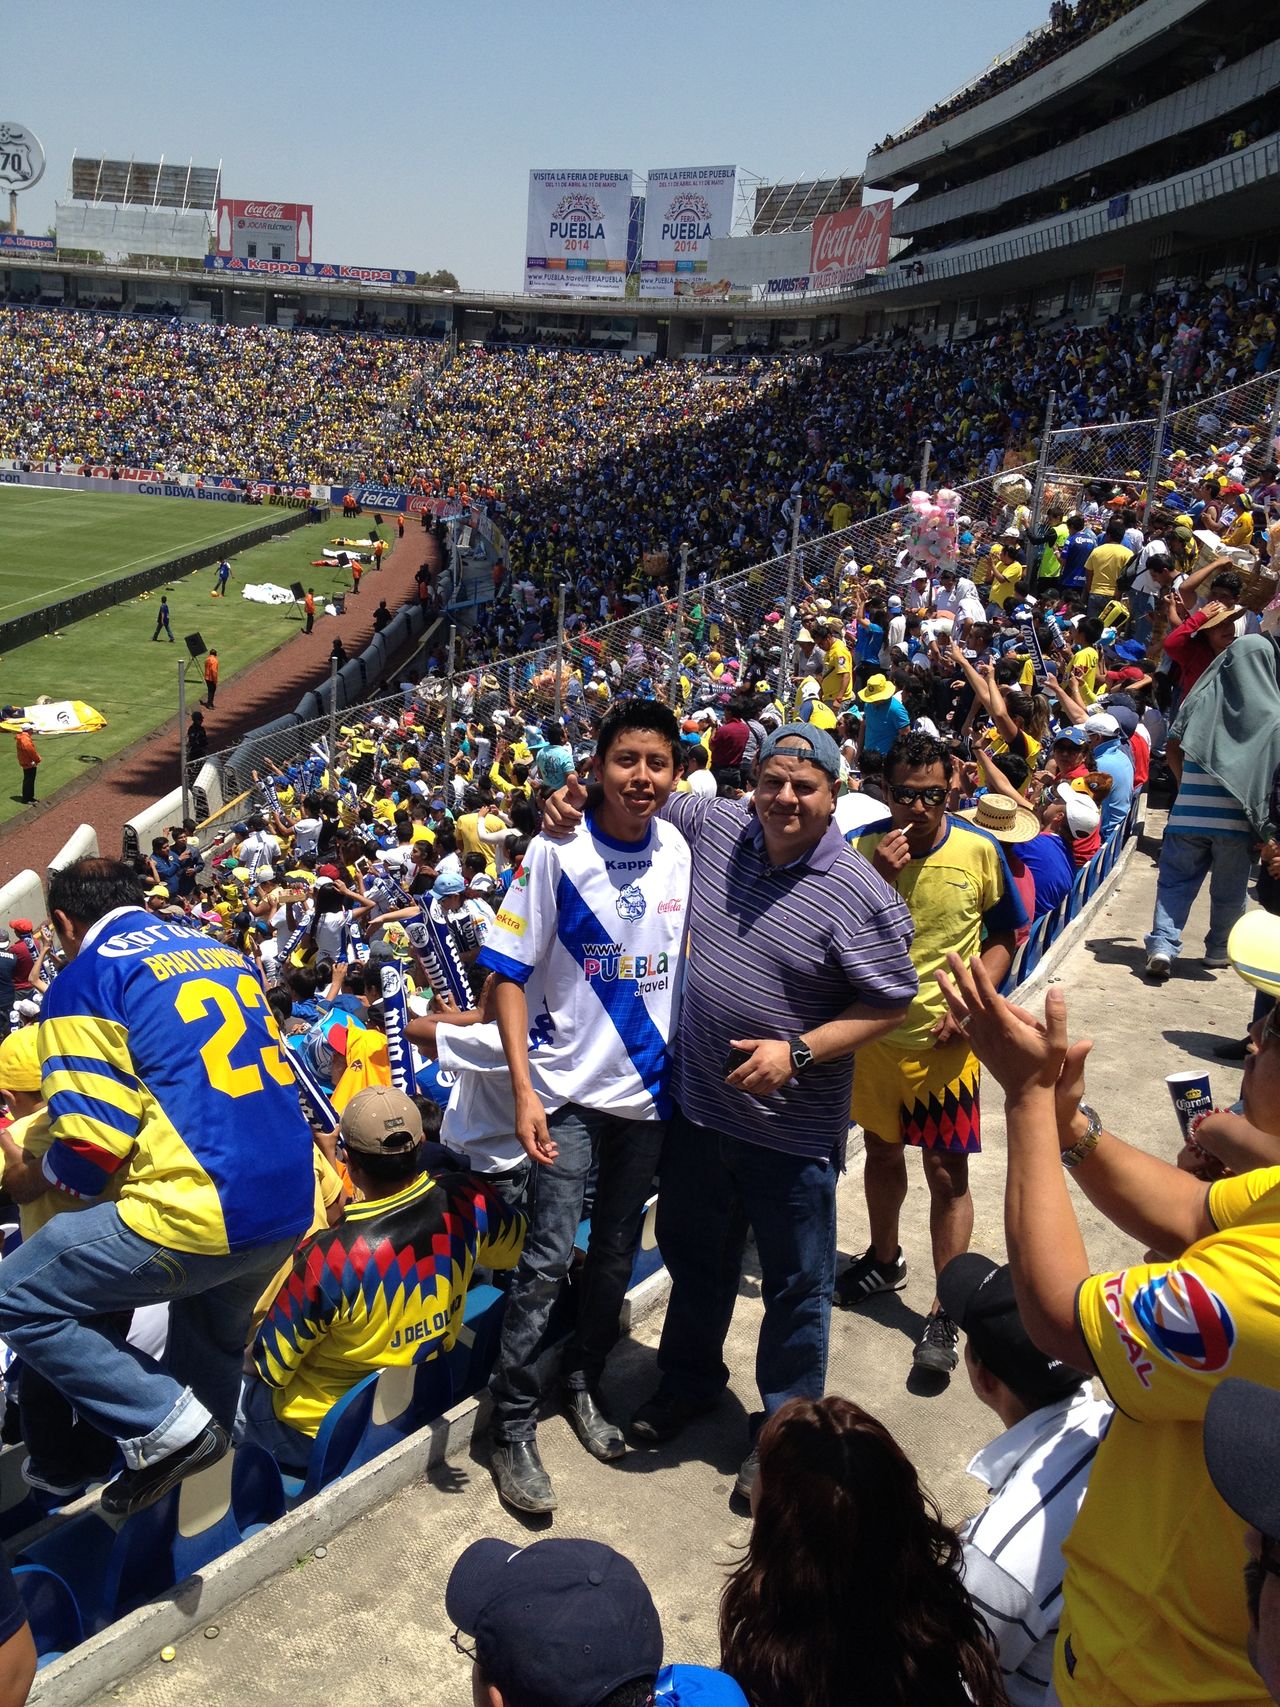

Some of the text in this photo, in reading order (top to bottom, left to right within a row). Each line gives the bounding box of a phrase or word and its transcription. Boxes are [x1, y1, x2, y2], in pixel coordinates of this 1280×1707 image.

[533, 172, 629, 181] VISITA LA FERIA DE PUEBLA
[648, 169, 736, 181] VISITA LA FERIA DE PUEBLA
[244, 202, 286, 219] Coca-Cola
[550, 222, 606, 239] PUEBLA
[661, 222, 712, 240] PUEBLA
[813, 204, 887, 272] Coca-Cola
[16, 237, 54, 249] Kappa
[564, 239, 590, 251] 2014
[674, 240, 698, 252] 2014
[247, 259, 300, 274] Kappa
[340, 265, 392, 281] Kappa
[138, 483, 162, 496] Con
[164, 486, 196, 499] BBVA
[360, 491, 401, 508] telcel
[605, 859, 653, 871] Kappa
[657, 898, 683, 915] Coca-Cola
[582, 942, 626, 956] www.
[634, 976, 669, 997] .travel
[174, 973, 296, 1099] 23
[1175, 1095, 1211, 1111] Corona
[390, 1330, 401, 1348] J
[405, 1318, 432, 1344] DEL
